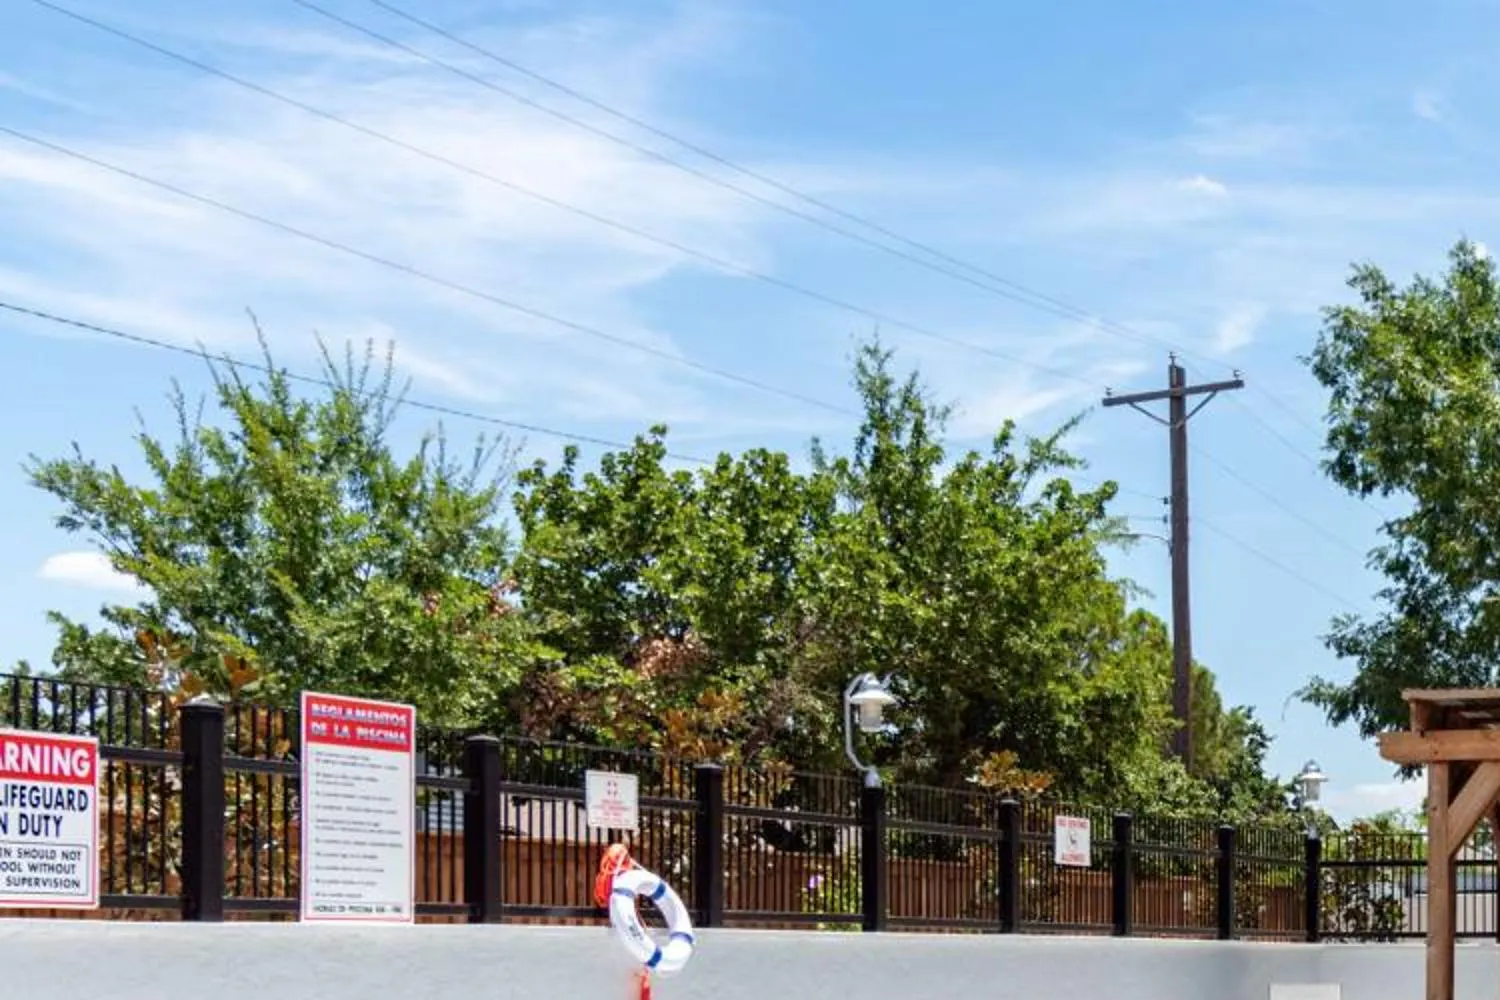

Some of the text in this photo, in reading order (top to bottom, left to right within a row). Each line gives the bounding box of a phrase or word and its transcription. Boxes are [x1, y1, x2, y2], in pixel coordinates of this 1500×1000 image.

[311, 721, 408, 745] DE LA PISCINA
[0, 741, 90, 779] RNING
[0, 783, 89, 812] IFEGUARD
[19, 812, 63, 838] DUTY
[18, 847, 56, 860] SHOULD
[61, 850, 81, 860] NOT
[28, 862, 76, 874] WITHOUT
[6, 876, 80, 889] SUPERVISION
